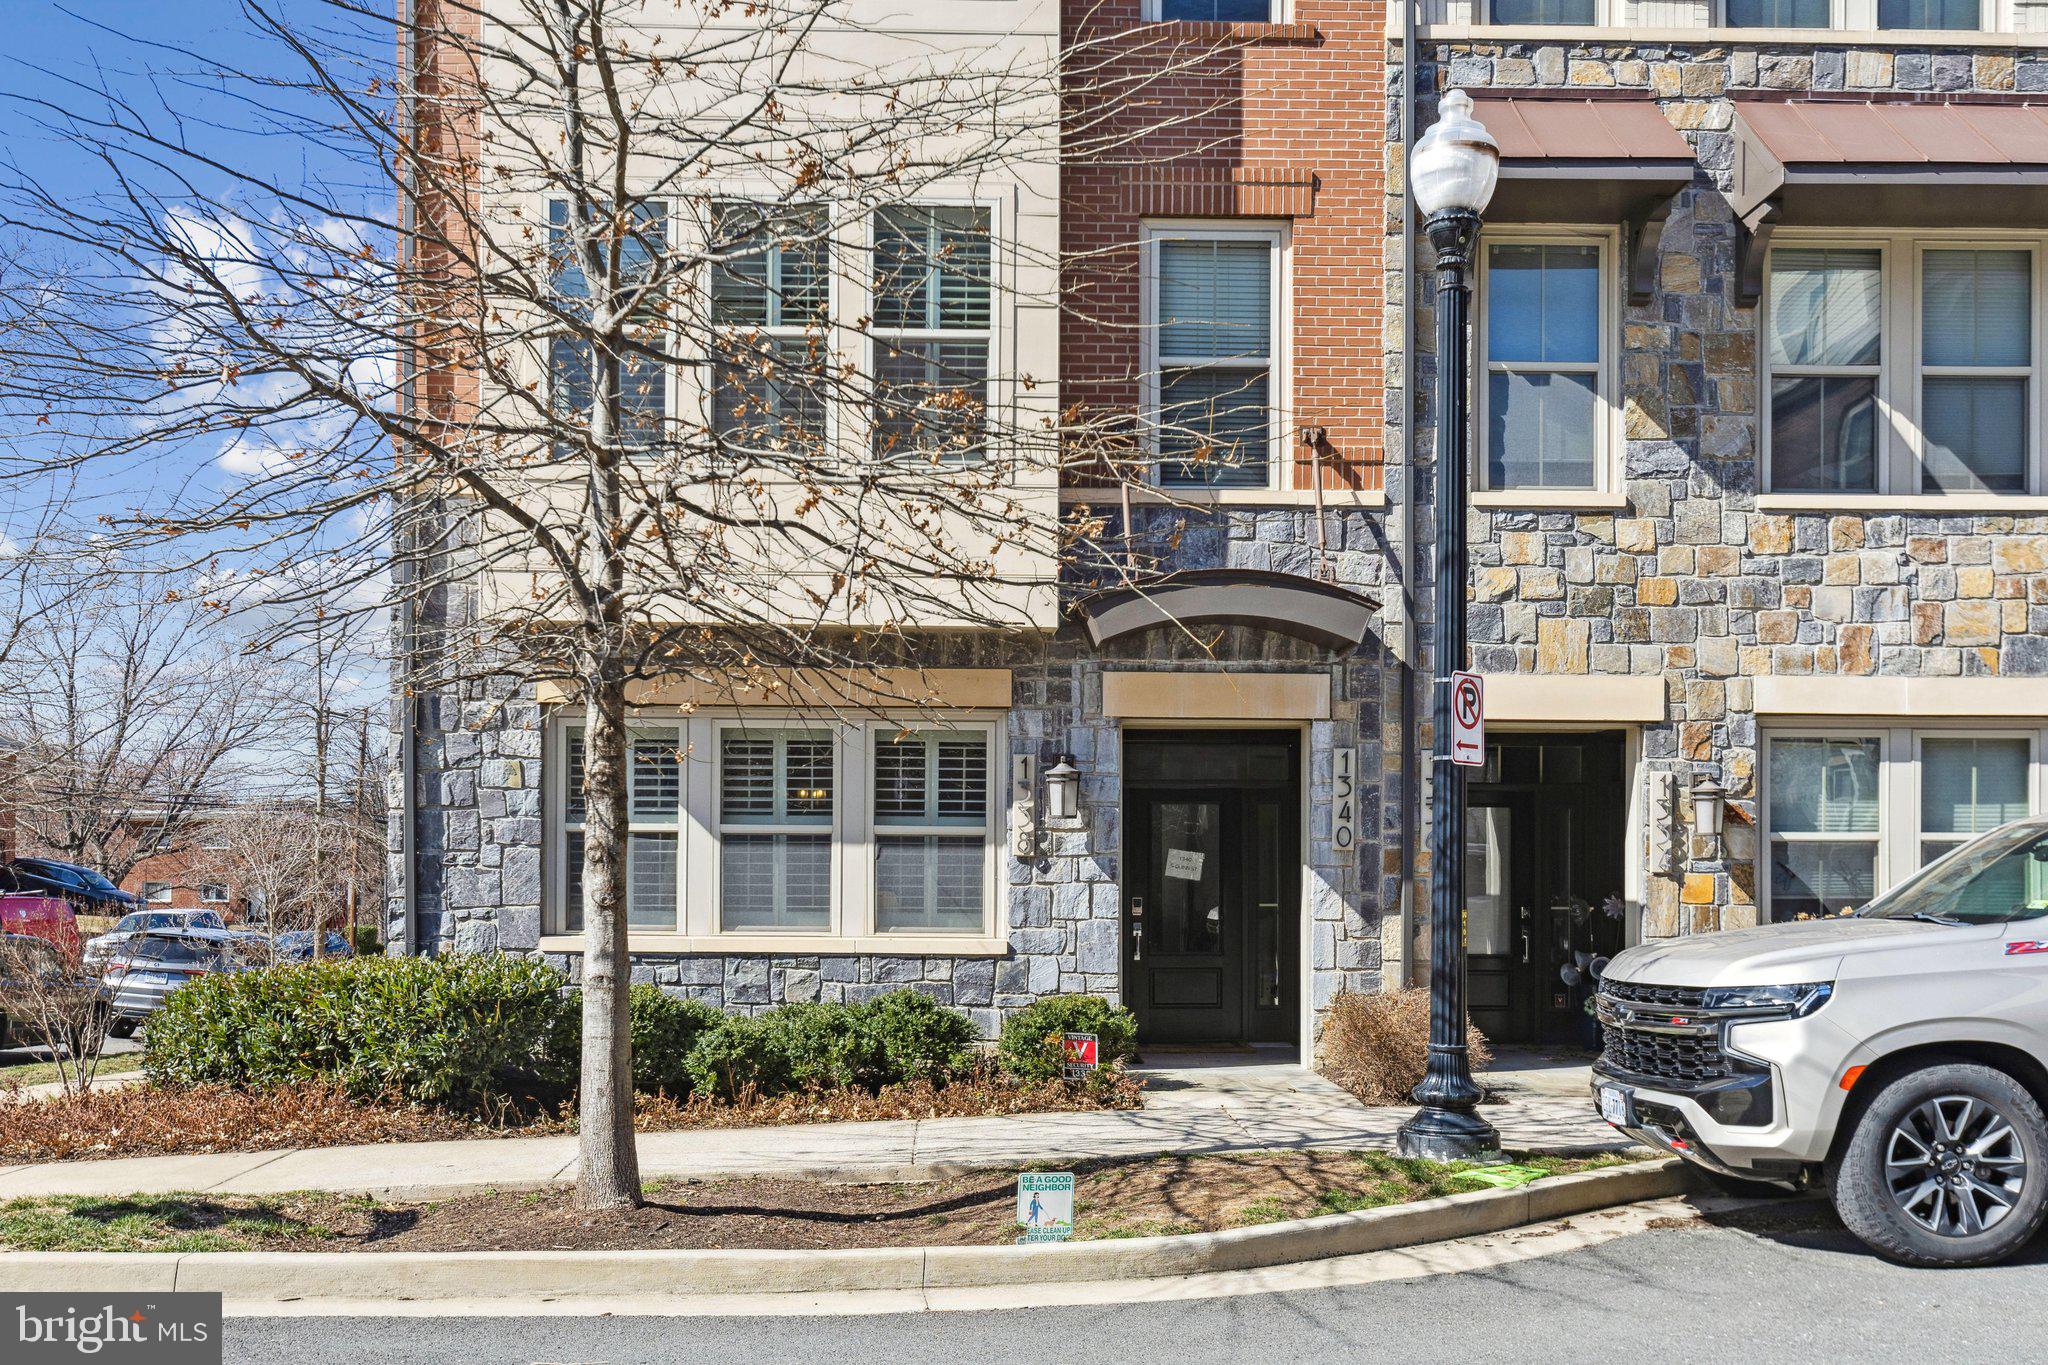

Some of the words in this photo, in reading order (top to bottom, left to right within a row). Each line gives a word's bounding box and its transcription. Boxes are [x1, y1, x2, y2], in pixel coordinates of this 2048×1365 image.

[1017, 755, 1032, 854] 1338
[1336, 750, 1352, 847] 1340
[1073, 1041, 1088, 1059] V
[1040, 1234, 1055, 1242] YOUR
